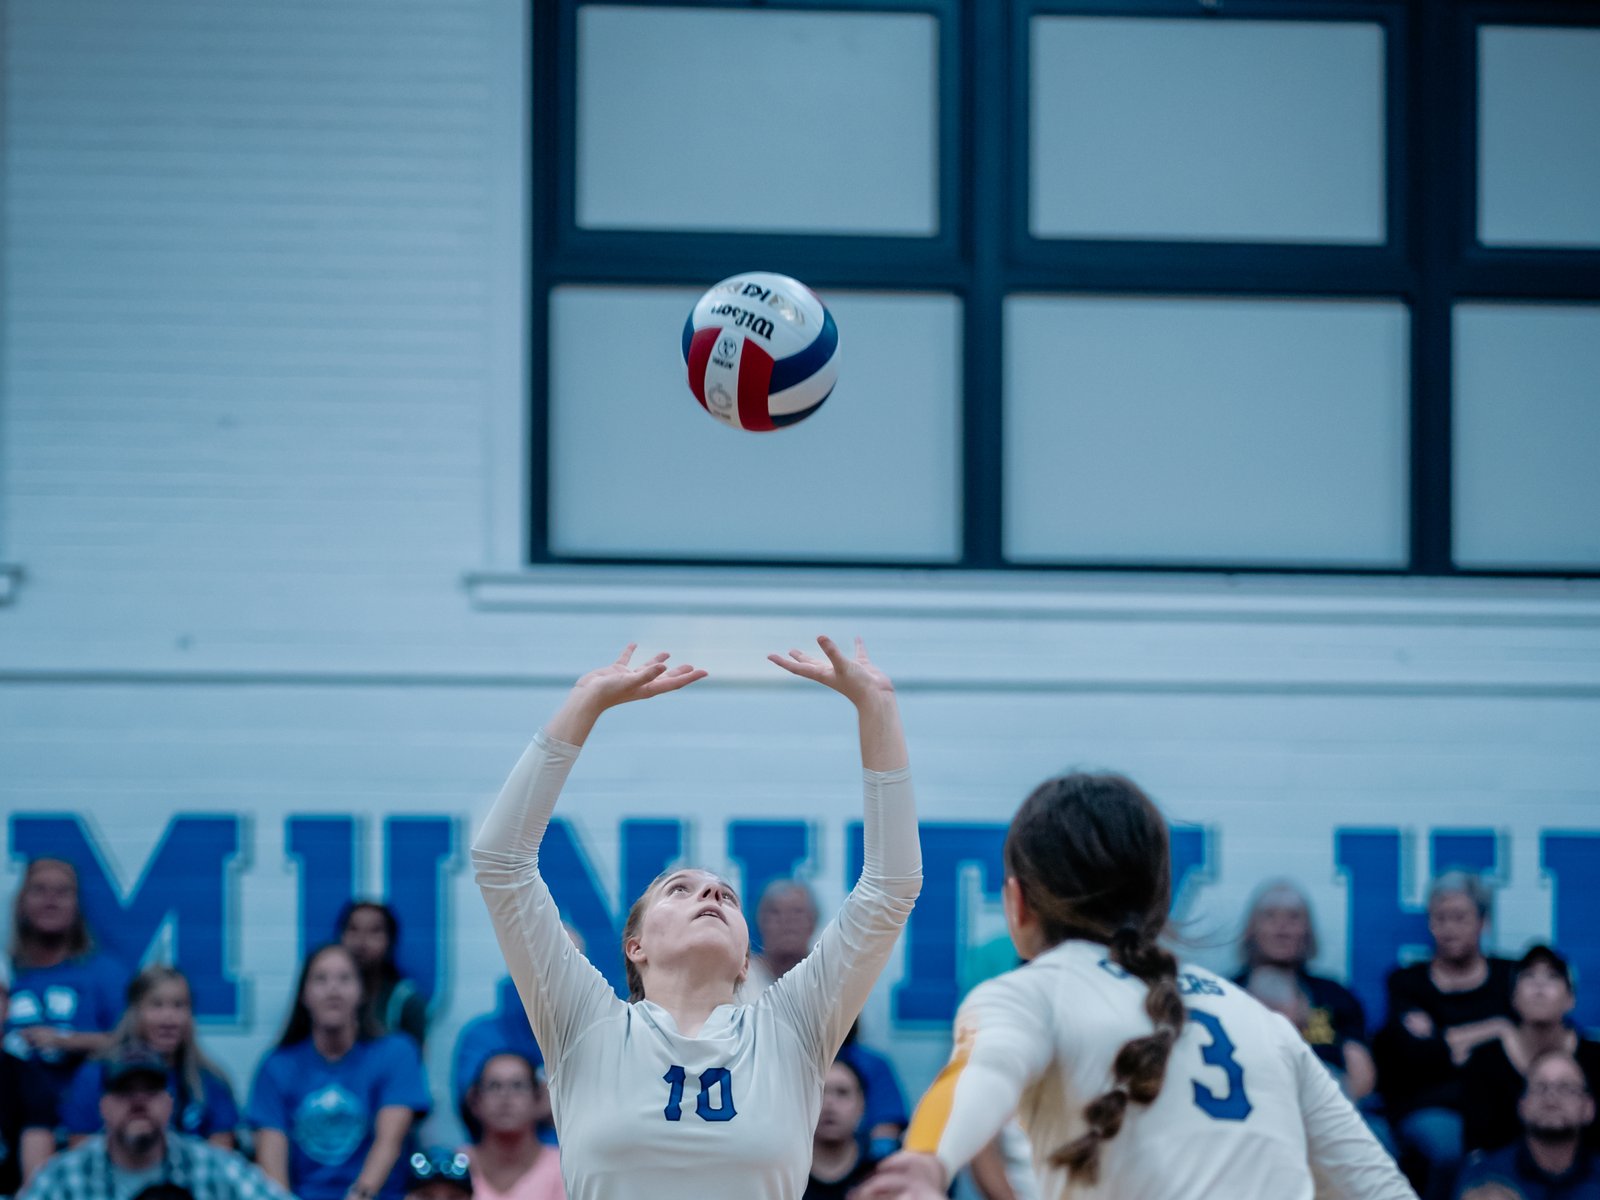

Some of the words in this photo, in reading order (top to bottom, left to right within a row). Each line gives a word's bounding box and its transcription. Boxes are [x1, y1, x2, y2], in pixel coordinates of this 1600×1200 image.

[710, 303, 775, 342] Wilson
[662, 1064, 738, 1122] 10
[1187, 1006, 1254, 1122] 3
